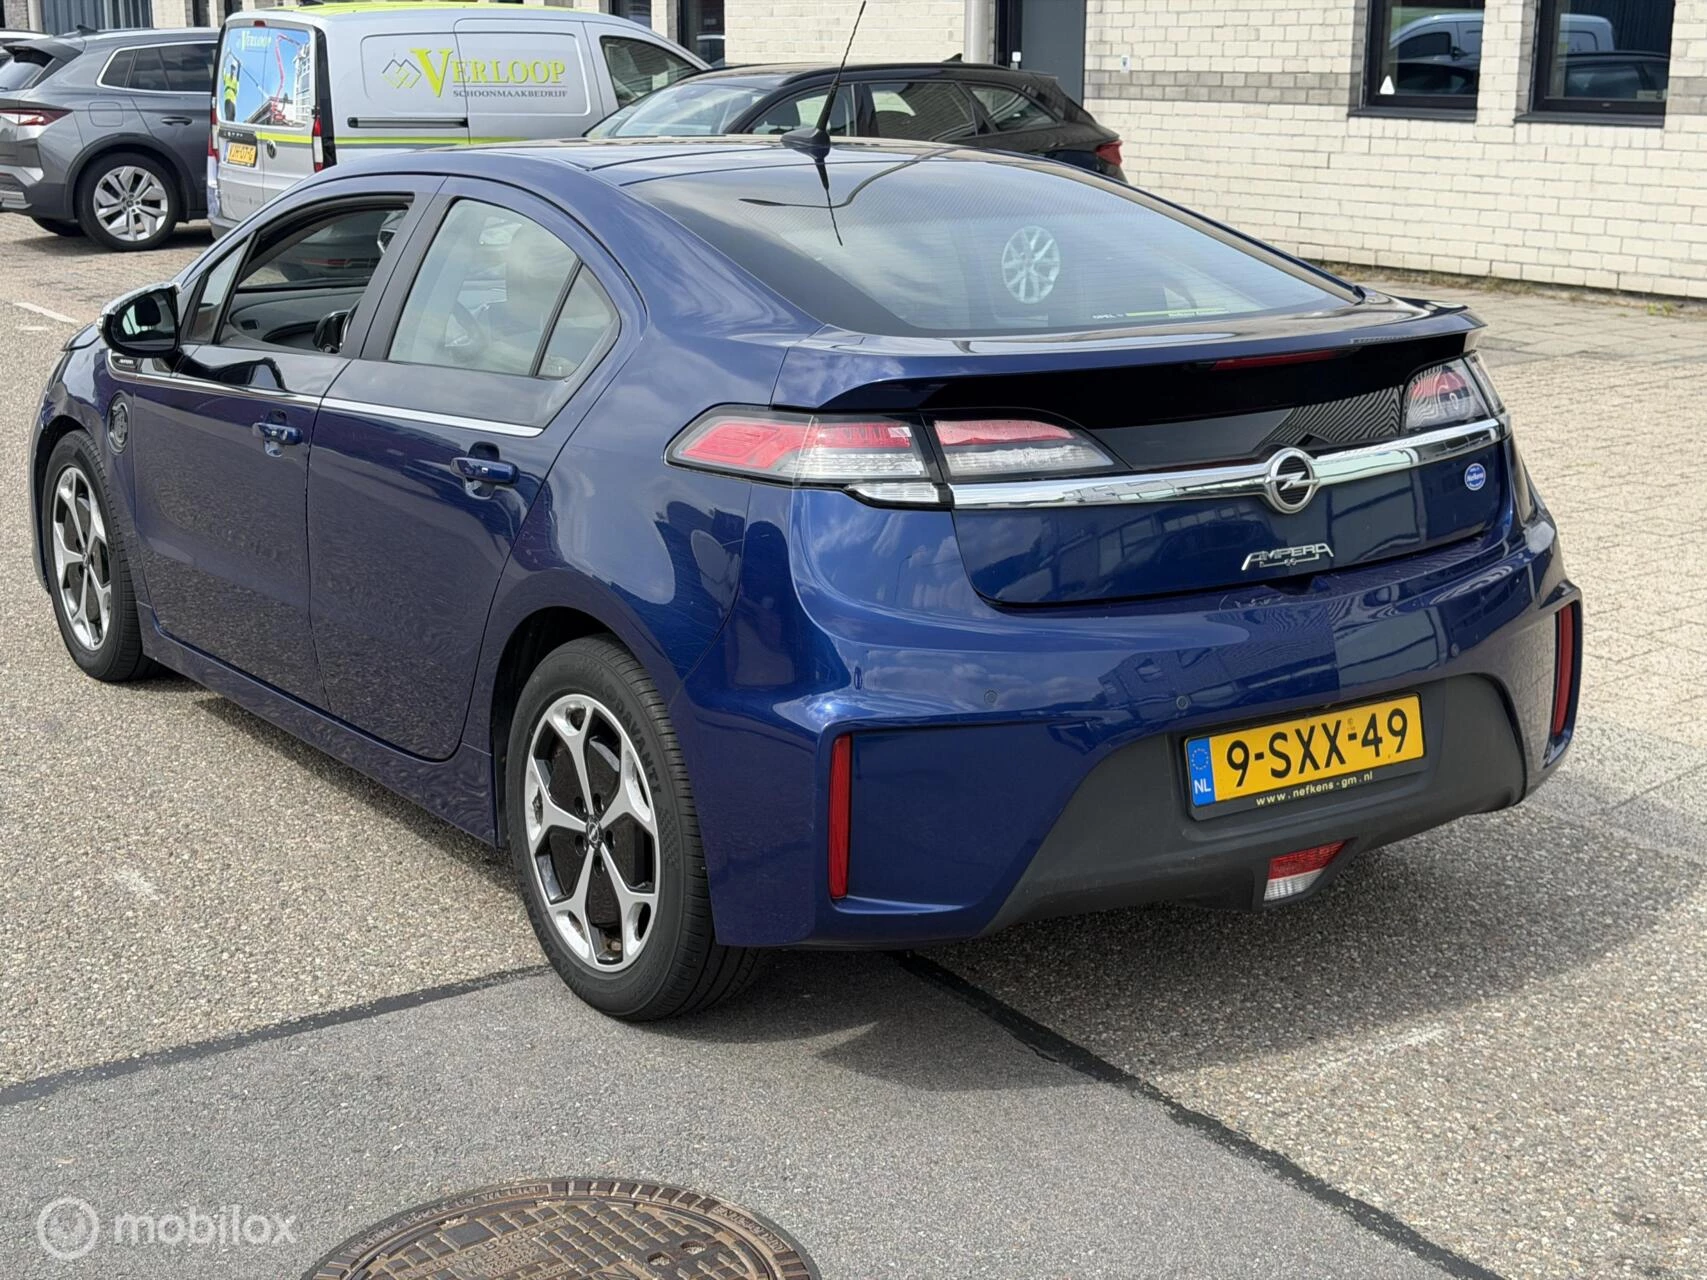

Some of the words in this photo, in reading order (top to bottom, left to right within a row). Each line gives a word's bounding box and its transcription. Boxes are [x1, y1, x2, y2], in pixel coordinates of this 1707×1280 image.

[410, 48, 566, 98] VERLOOP
[453, 90, 568, 98] SCHOONMAAKBEDRIJF
[1241, 543, 1334, 571] AMPERA
[1226, 707, 1409, 787] 9-SXX-49
[1194, 777, 1212, 794] NL
